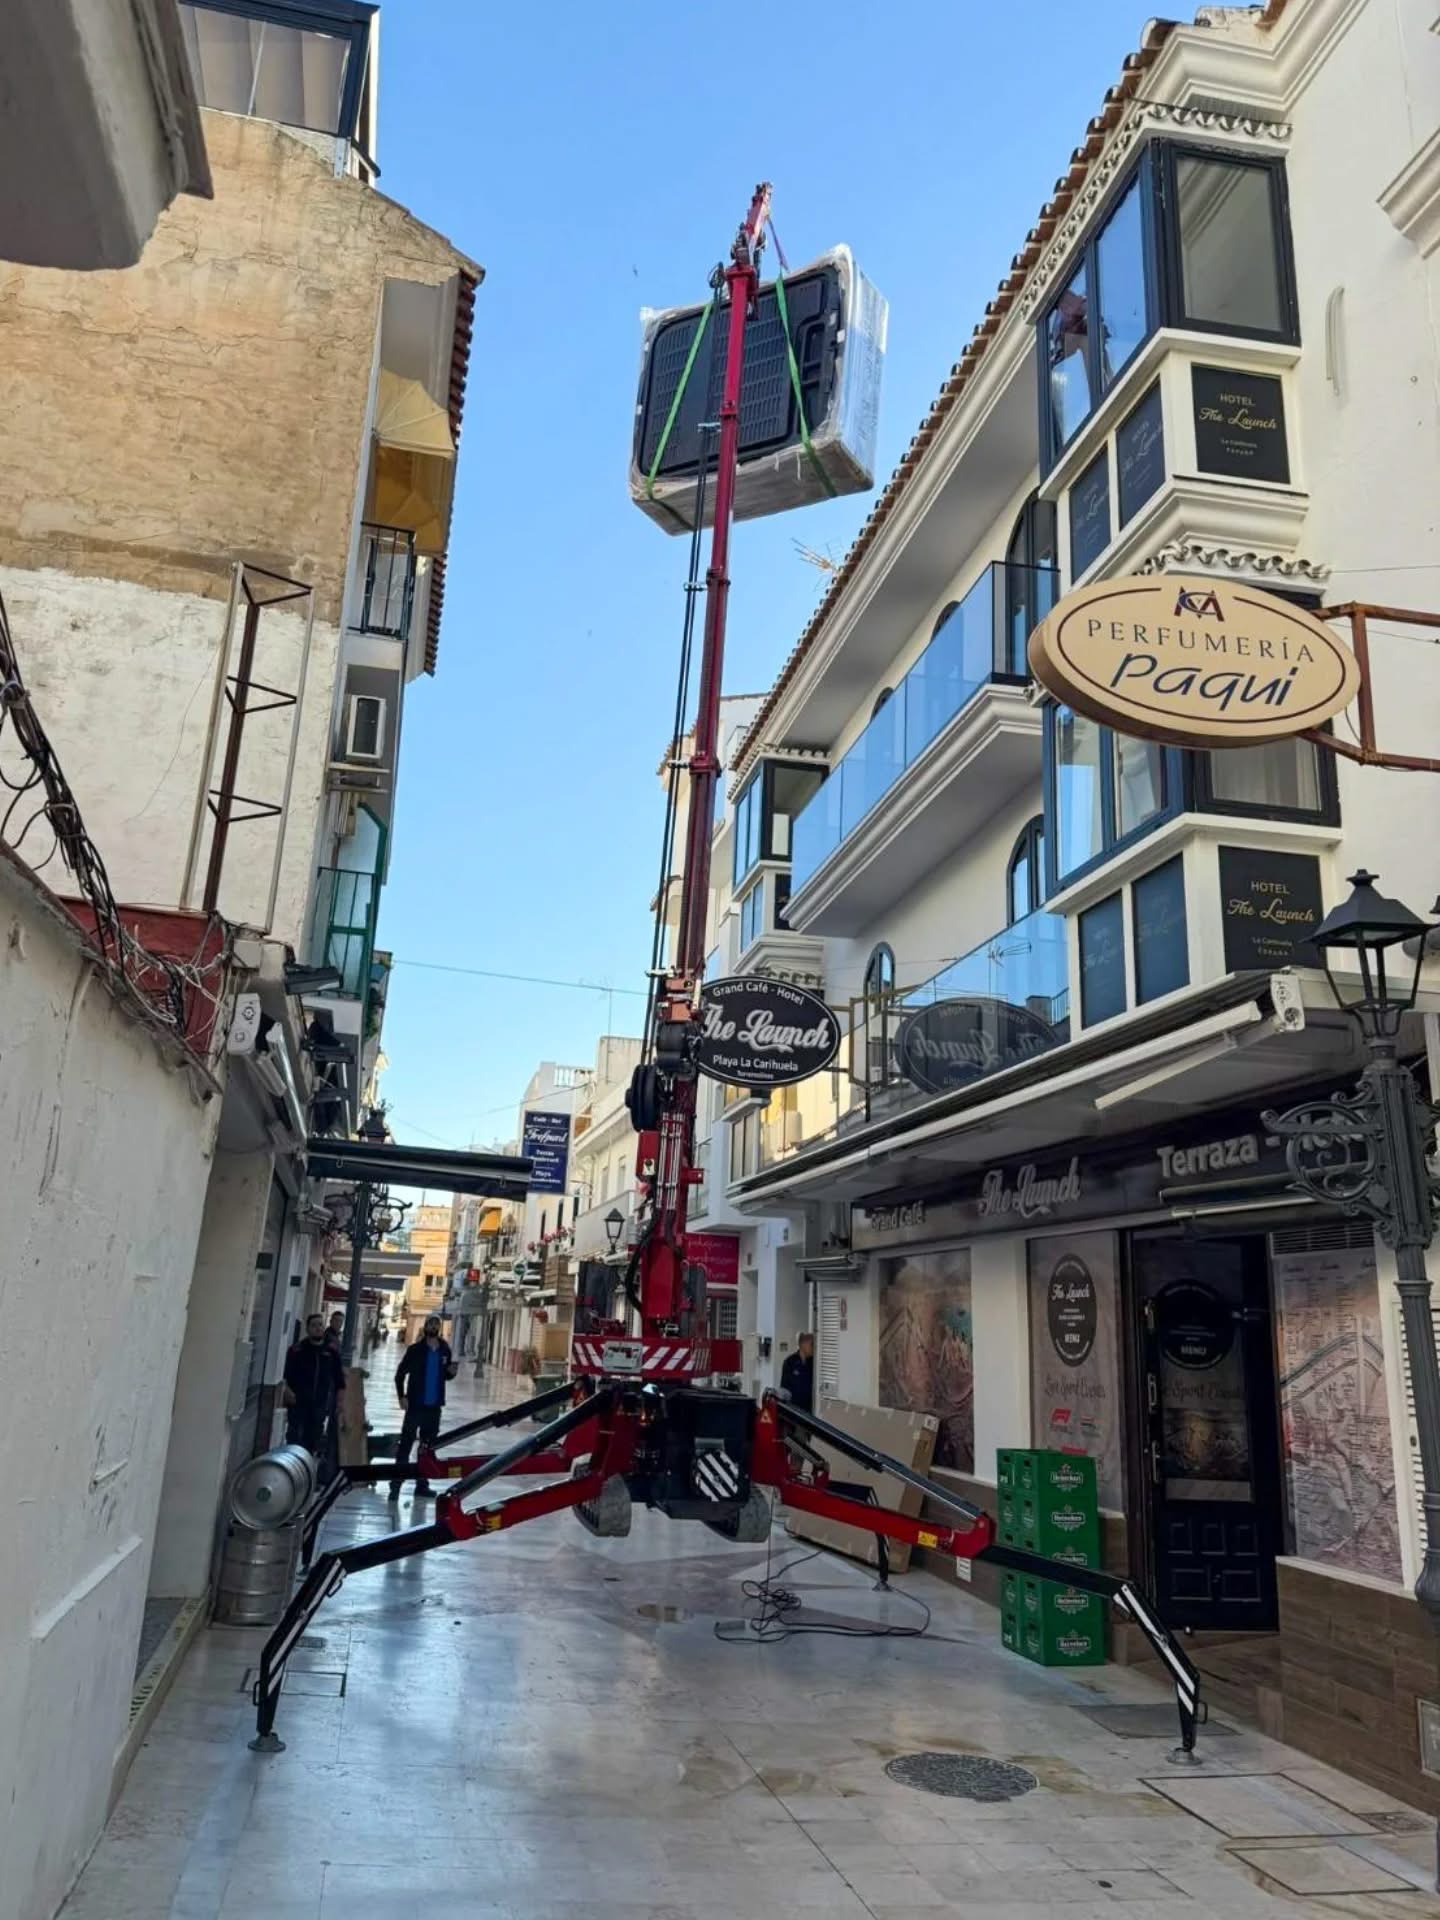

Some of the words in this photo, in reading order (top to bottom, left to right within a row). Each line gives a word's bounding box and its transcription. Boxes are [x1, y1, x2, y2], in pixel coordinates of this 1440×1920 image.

[1219, 392, 1256, 406] HOTEL
[1199, 407, 1225, 422] The
[1227, 408, 1278, 430] Launch
[1087, 618, 1315, 664] PERFUMERÍA
[1250, 880, 1291, 895] HOTEL
[1226, 898, 1256, 916] The
[1259, 897, 1314, 925] Launch
[712, 982, 744, 997] Grand
[745, 981, 769, 994] Café
[776, 988, 806, 1006] Hotel
[701, 1002, 737, 1042] The
[737, 1009, 832, 1054] Launch
[713, 1054, 738, 1068] Playa
[740, 1056, 751, 1068] La
[753, 1057, 799, 1072] Carihuela
[1156, 1134, 1259, 1179] Terraza
[978, 1169, 1012, 1217] The
[1013, 1156, 1081, 1219] Launch
[871, 1207, 898, 1232] Grand
[899, 1200, 927, 1228] Café
